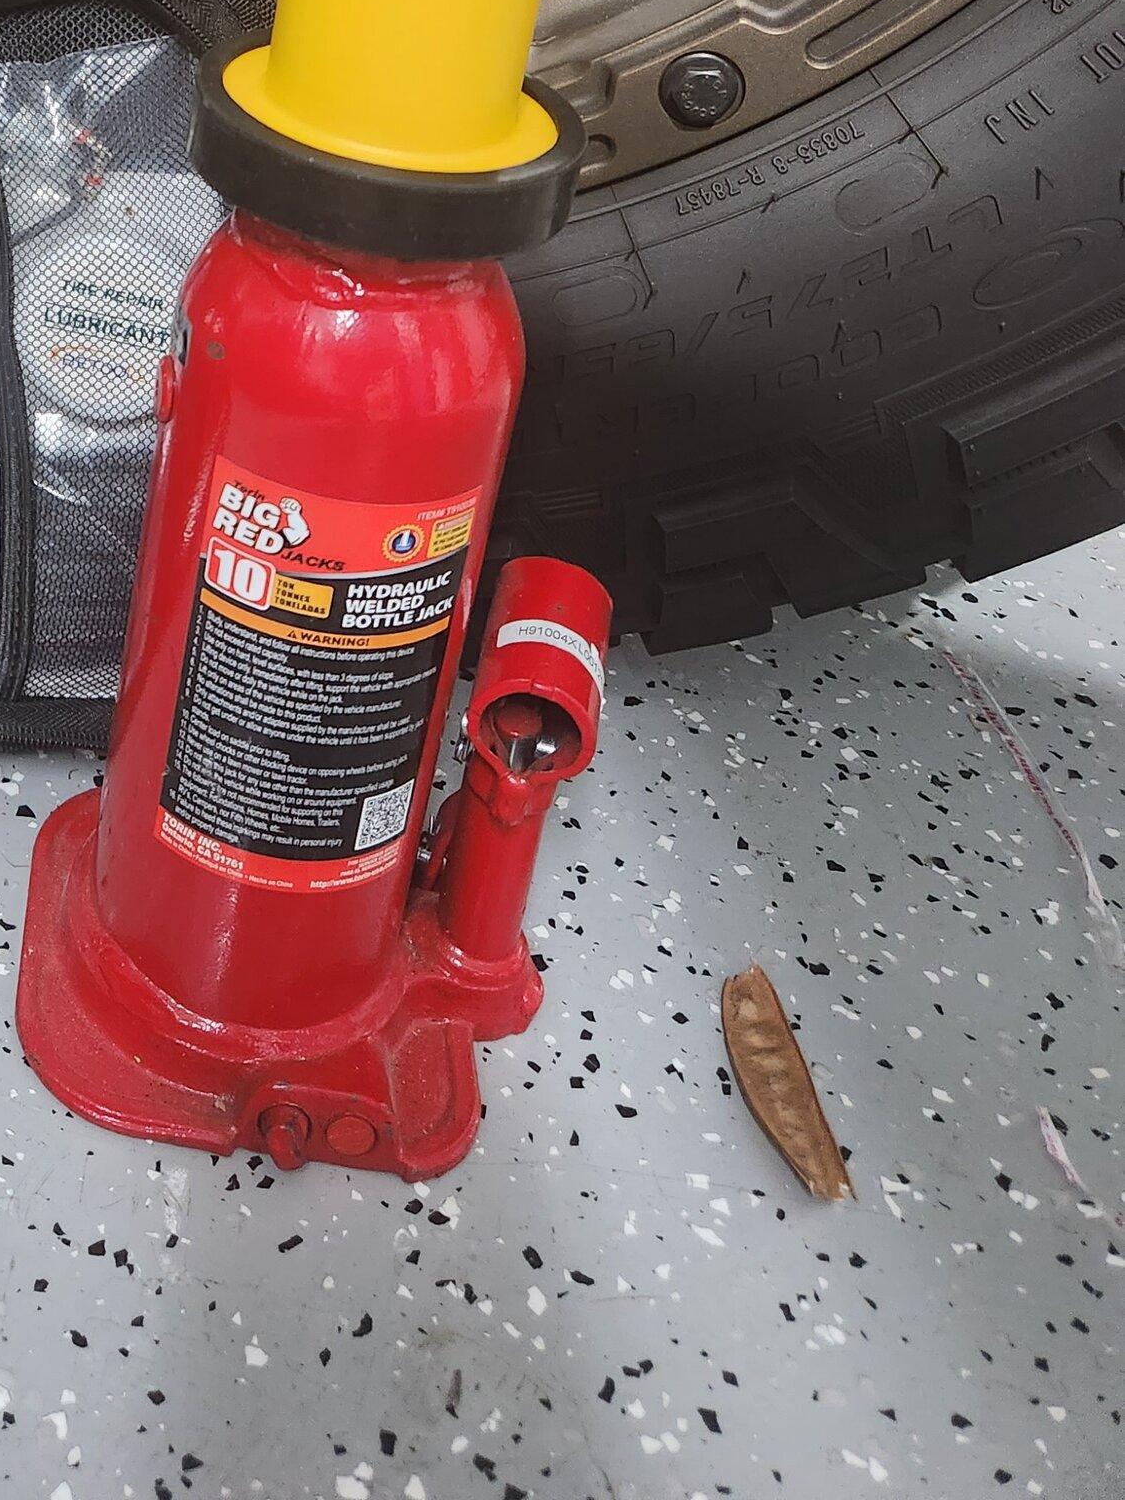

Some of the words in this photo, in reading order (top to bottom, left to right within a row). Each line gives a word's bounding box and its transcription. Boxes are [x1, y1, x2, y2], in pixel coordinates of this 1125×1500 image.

[772, 119, 866, 175] 70835-8
[675, 168, 766, 217] R-78457
[45, 307, 171, 347] LUBRICANT
[219, 482, 281, 529] BIG
[212, 506, 285, 554] RED
[280, 550, 347, 571] JACKS
[213, 548, 268, 603] 10
[277, 579, 295, 591] TON
[347, 570, 453, 599] HYDRAULIC
[276, 589, 310, 603] TONNES
[345, 594, 425, 614] WELDED
[275, 597, 327, 615] TONELADAS
[341, 613, 414, 629] BOTTLE
[415, 595, 455, 622] JACK
[204, 631, 215, 644] Use
[206, 621, 214, 632] Do
[214, 628, 224, 638] not
[300, 631, 371, 647] WARNING!
[300, 646, 336, 660] instructions
[336, 652, 357, 661] before
[357, 652, 385, 662] operating
[268, 684, 290, 696] vehicle
[326, 685, 349, 693] support
[350, 685, 360, 693] the
[361, 684, 381, 693] vehicle
[263, 695, 285, 706] vehicle
[317, 737, 338, 745] vehicle
[317, 768, 345, 778] opposing
[163, 812, 196, 840] TORIN
[198, 836, 222, 854] INC.
[162, 822, 195, 851] Ontario,
[197, 845, 212, 858] CA
[213, 852, 244, 870] 91761
